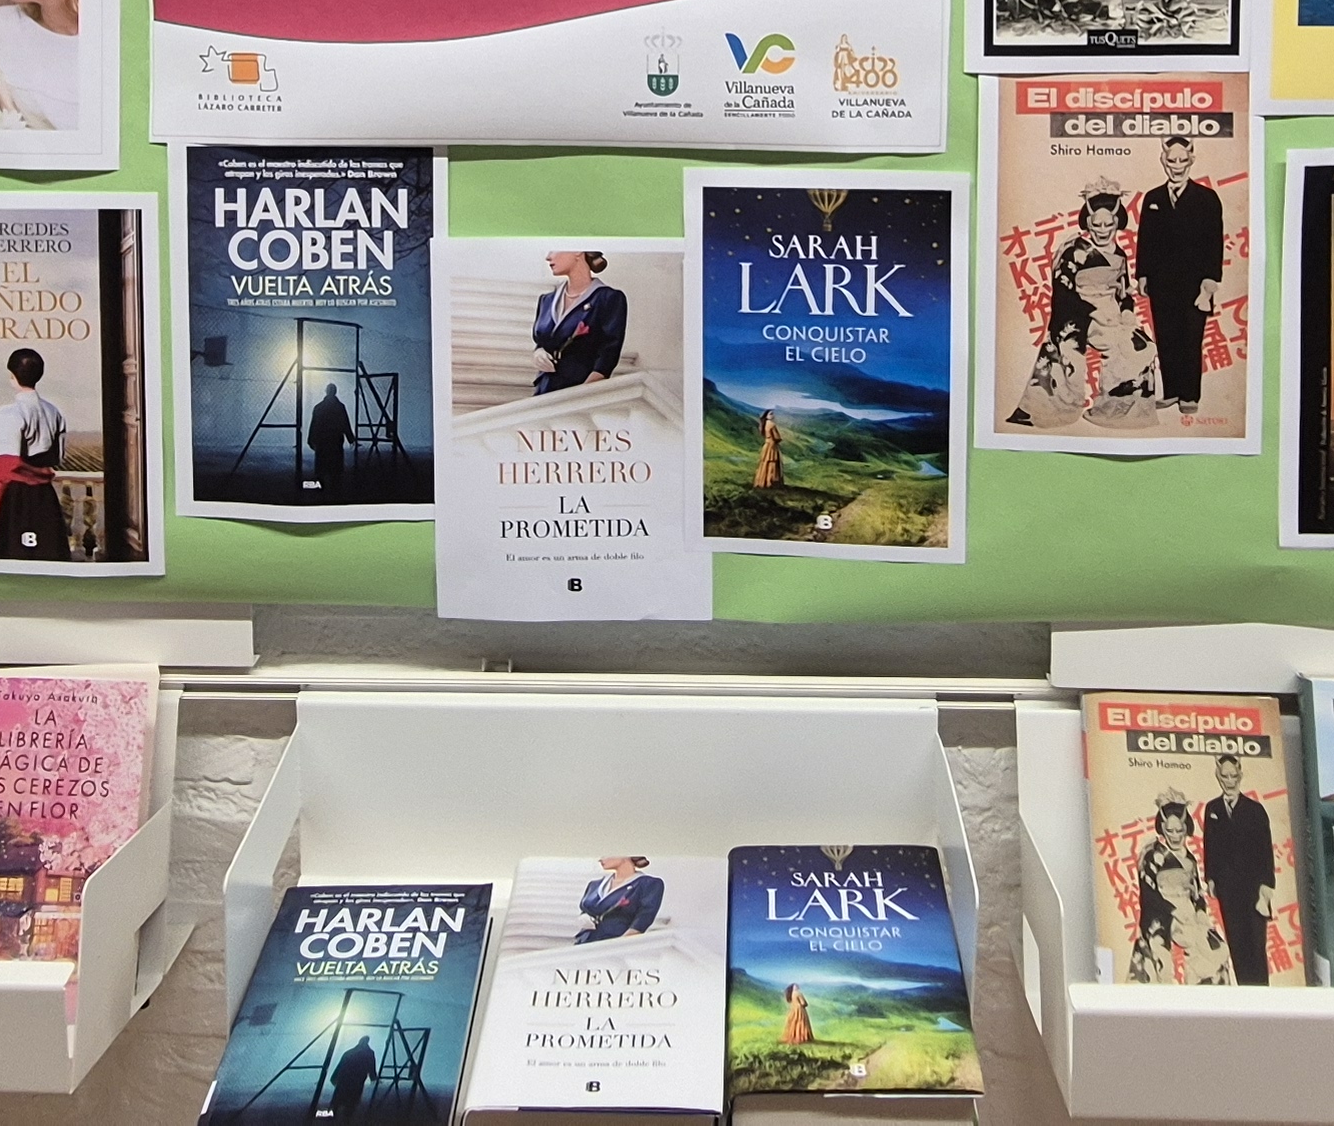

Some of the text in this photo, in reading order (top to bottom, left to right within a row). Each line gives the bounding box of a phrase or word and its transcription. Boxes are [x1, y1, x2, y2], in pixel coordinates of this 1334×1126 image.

[198, 94, 282, 102] BIBLIOTECA
[725, 81, 795, 96] Villanueva
[198, 102, 234, 111] LÁZARO
[838, 98, 906, 107] VILLANUEVA
[1027, 88, 1213, 114] El discípulo
[831, 108, 912, 118] DE LA CAÑADA
[1065, 115, 1220, 135] del diablo
[1050, 144, 1131, 156] Shiro Hamao
[215, 187, 408, 228] HARLAN
[228, 229, 393, 270] COBEN
[769, 235, 878, 260] SARAH
[231, 270, 392, 296] VUELTA ATRÁS
[738, 262, 914, 317] LARK
[762, 324, 890, 344] CONQUISTAR
[518, 429, 632, 453] NIEVES
[498, 461, 652, 485] HERRERO
[500, 519, 650, 539] PROMETIDA
[1137, 733, 1261, 755] del diablo
[78, 757, 104, 773] DE
[13, 778, 110, 798] CEREZOS
[791, 872, 883, 888] SARAH
[766, 888, 919, 921] LARK
[294, 907, 466, 933] HARLAN
[300, 932, 447, 959] COBEN
[525, 1034, 672, 1049] PROMETIDA
